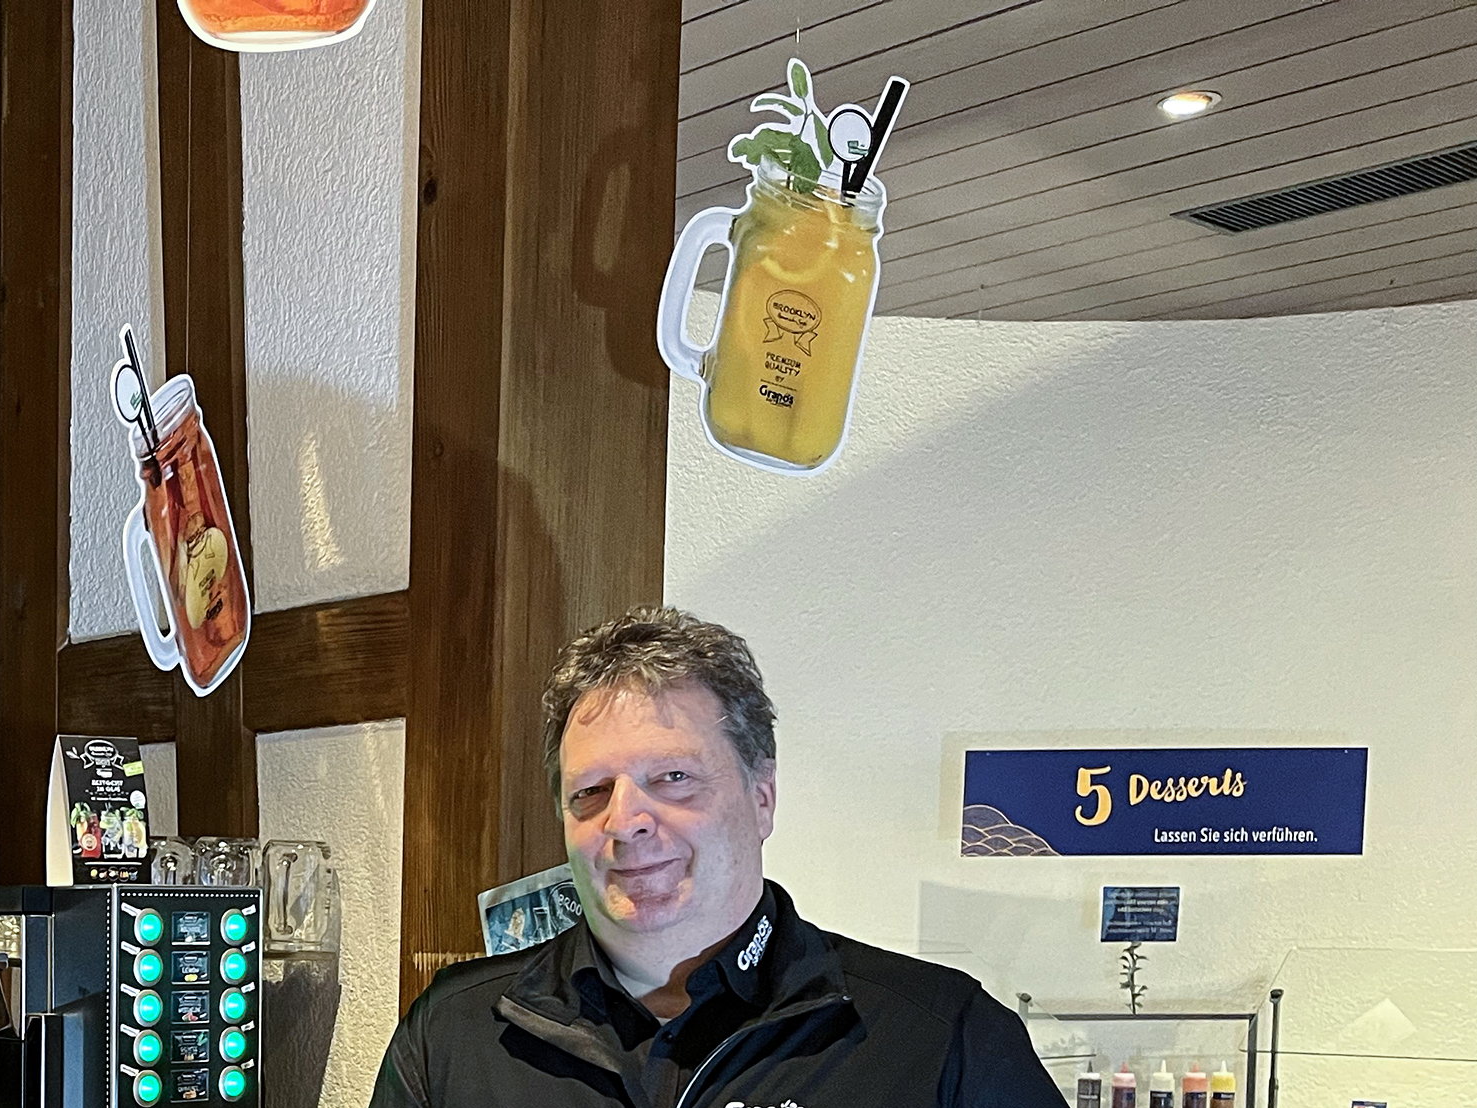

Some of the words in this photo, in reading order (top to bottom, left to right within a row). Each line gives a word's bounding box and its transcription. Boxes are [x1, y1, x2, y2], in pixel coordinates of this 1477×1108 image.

[773, 302, 816, 321] BROOKLYN
[1075, 765, 1112, 827] 5
[1129, 768, 1248, 806] Desserts
[1154, 827, 1197, 843] Lassen
[1200, 827, 1221, 843] Sie
[1223, 826, 1249, 843] sich
[1252, 826, 1318, 843] verführen.
